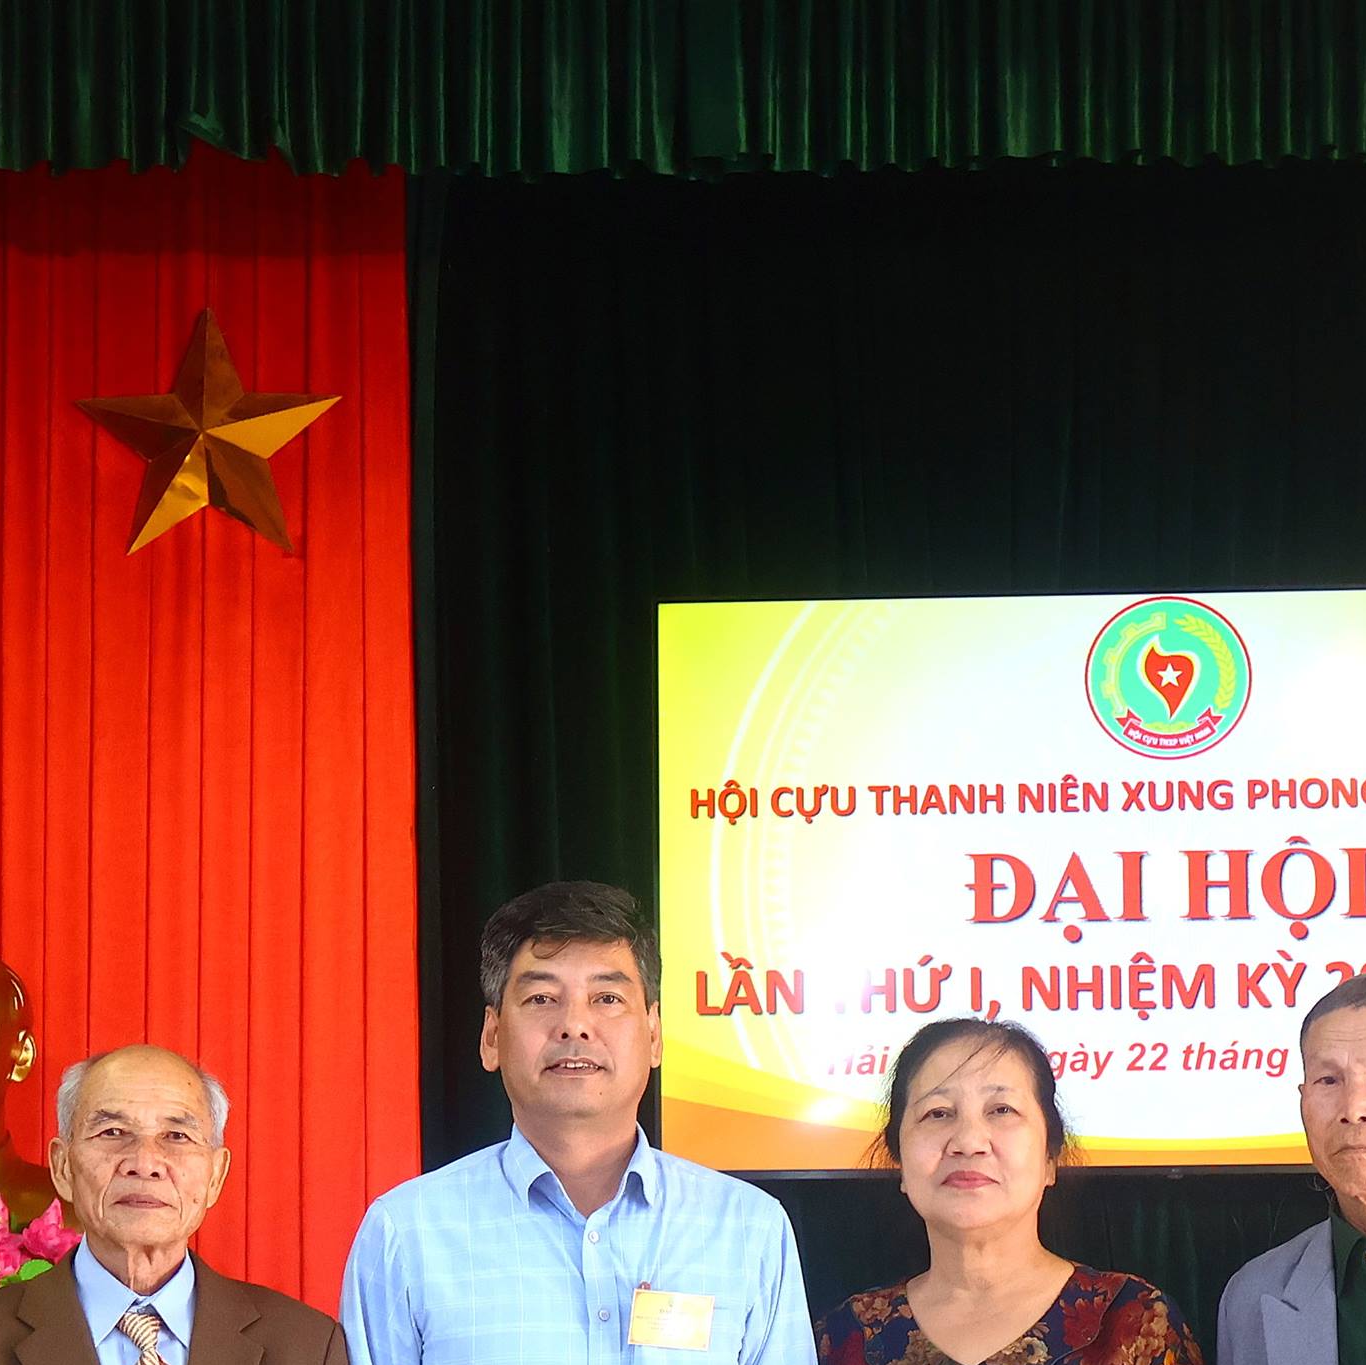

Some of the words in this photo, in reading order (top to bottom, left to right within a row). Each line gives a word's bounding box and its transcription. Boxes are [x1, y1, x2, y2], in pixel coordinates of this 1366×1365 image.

[690, 779, 759, 825] HỘI
[770, 783, 857, 824] CỰU
[867, 783, 1005, 816] THANH
[1018, 774, 1110, 814] NIÊN
[1121, 779, 1234, 812] XUNG
[964, 851, 1151, 943] ĐẠI
[696, 951, 804, 1016] LẦN
[835, 954, 952, 1014] HỨ
[1021, 951, 1216, 1021] NHIỆM
[1237, 949, 1307, 1009] KỲ
[1049, 1042, 1115, 1081] gày
[1126, 1042, 1169, 1072] 22
[1182, 1040, 1290, 1078] tháng
